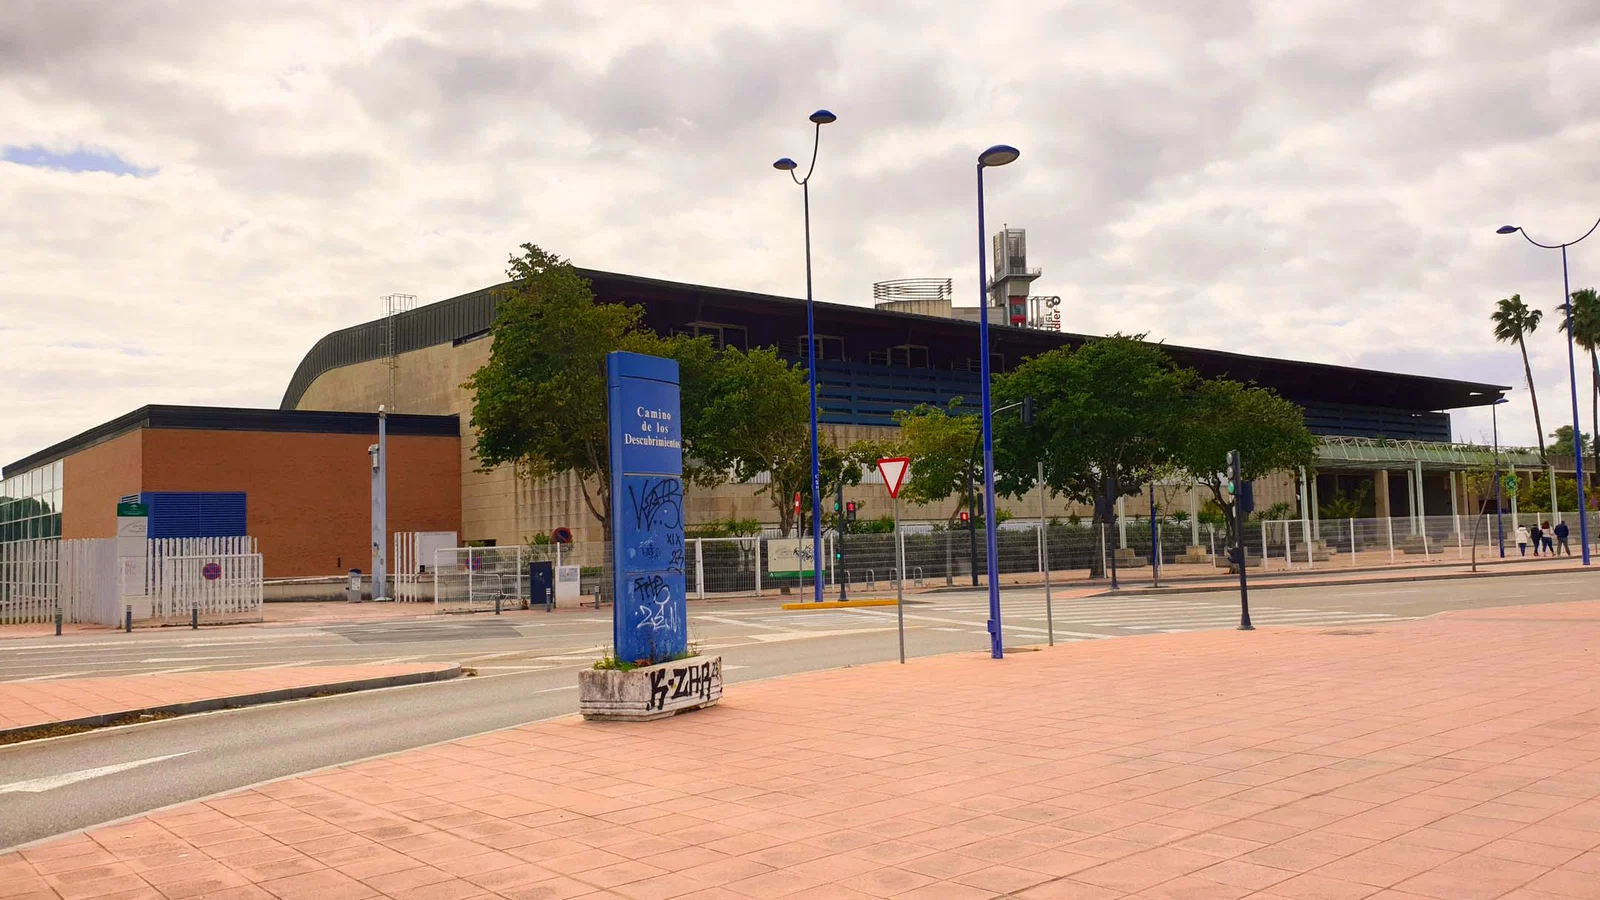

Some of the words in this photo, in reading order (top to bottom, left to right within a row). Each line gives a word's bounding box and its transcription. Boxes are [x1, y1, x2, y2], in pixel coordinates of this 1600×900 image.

[636, 406, 672, 421] Camino
[641, 421, 652, 432] de
[656, 422, 669, 434] los
[624, 433, 681, 449] Descubrimientos
